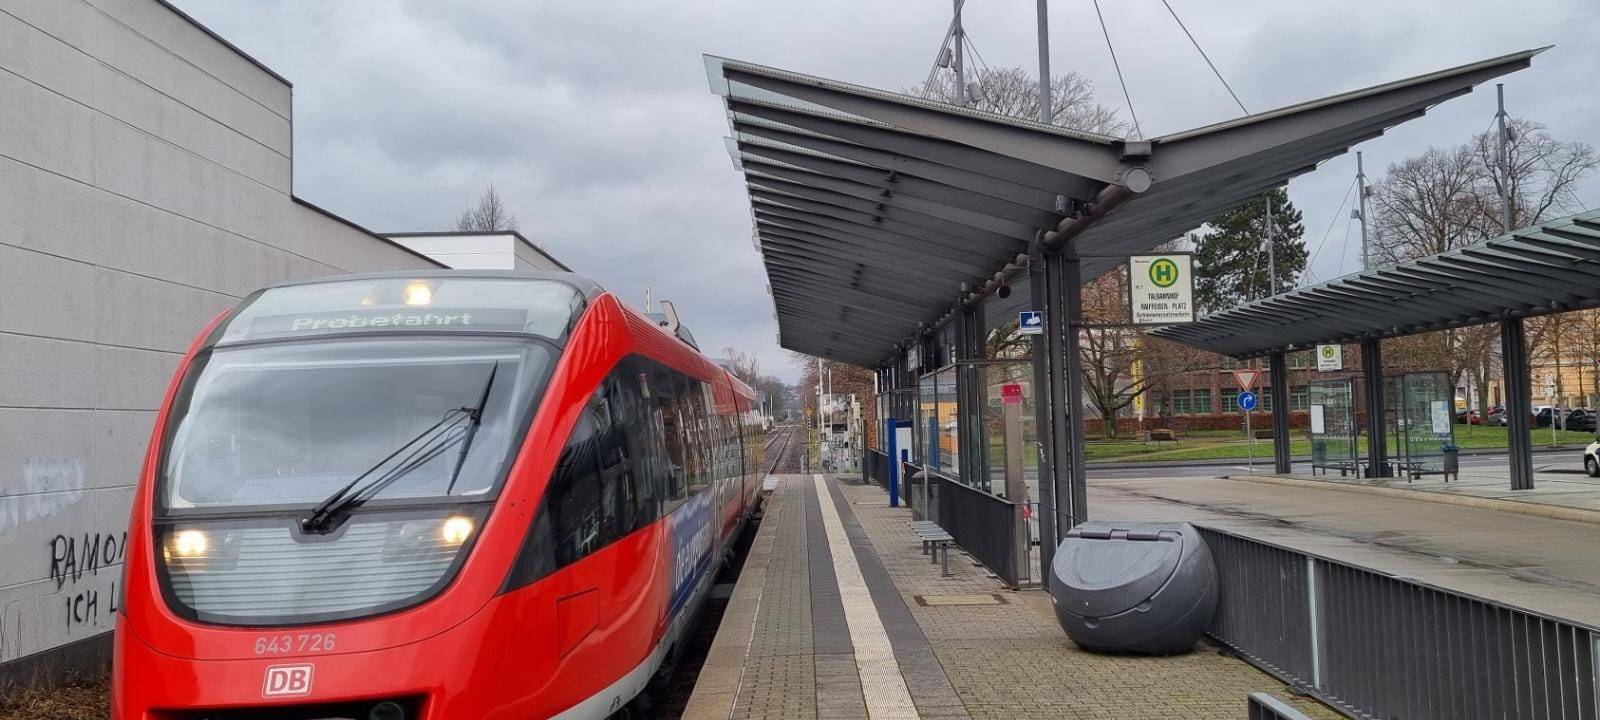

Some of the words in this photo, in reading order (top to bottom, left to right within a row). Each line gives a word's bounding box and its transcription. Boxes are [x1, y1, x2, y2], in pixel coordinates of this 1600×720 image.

[291, 312, 472, 331] Probefahrt
[66, 590, 98, 635] ICH
[254, 635, 293, 655] 643
[297, 633, 336, 652] 726
[269, 669, 307, 692] DB
